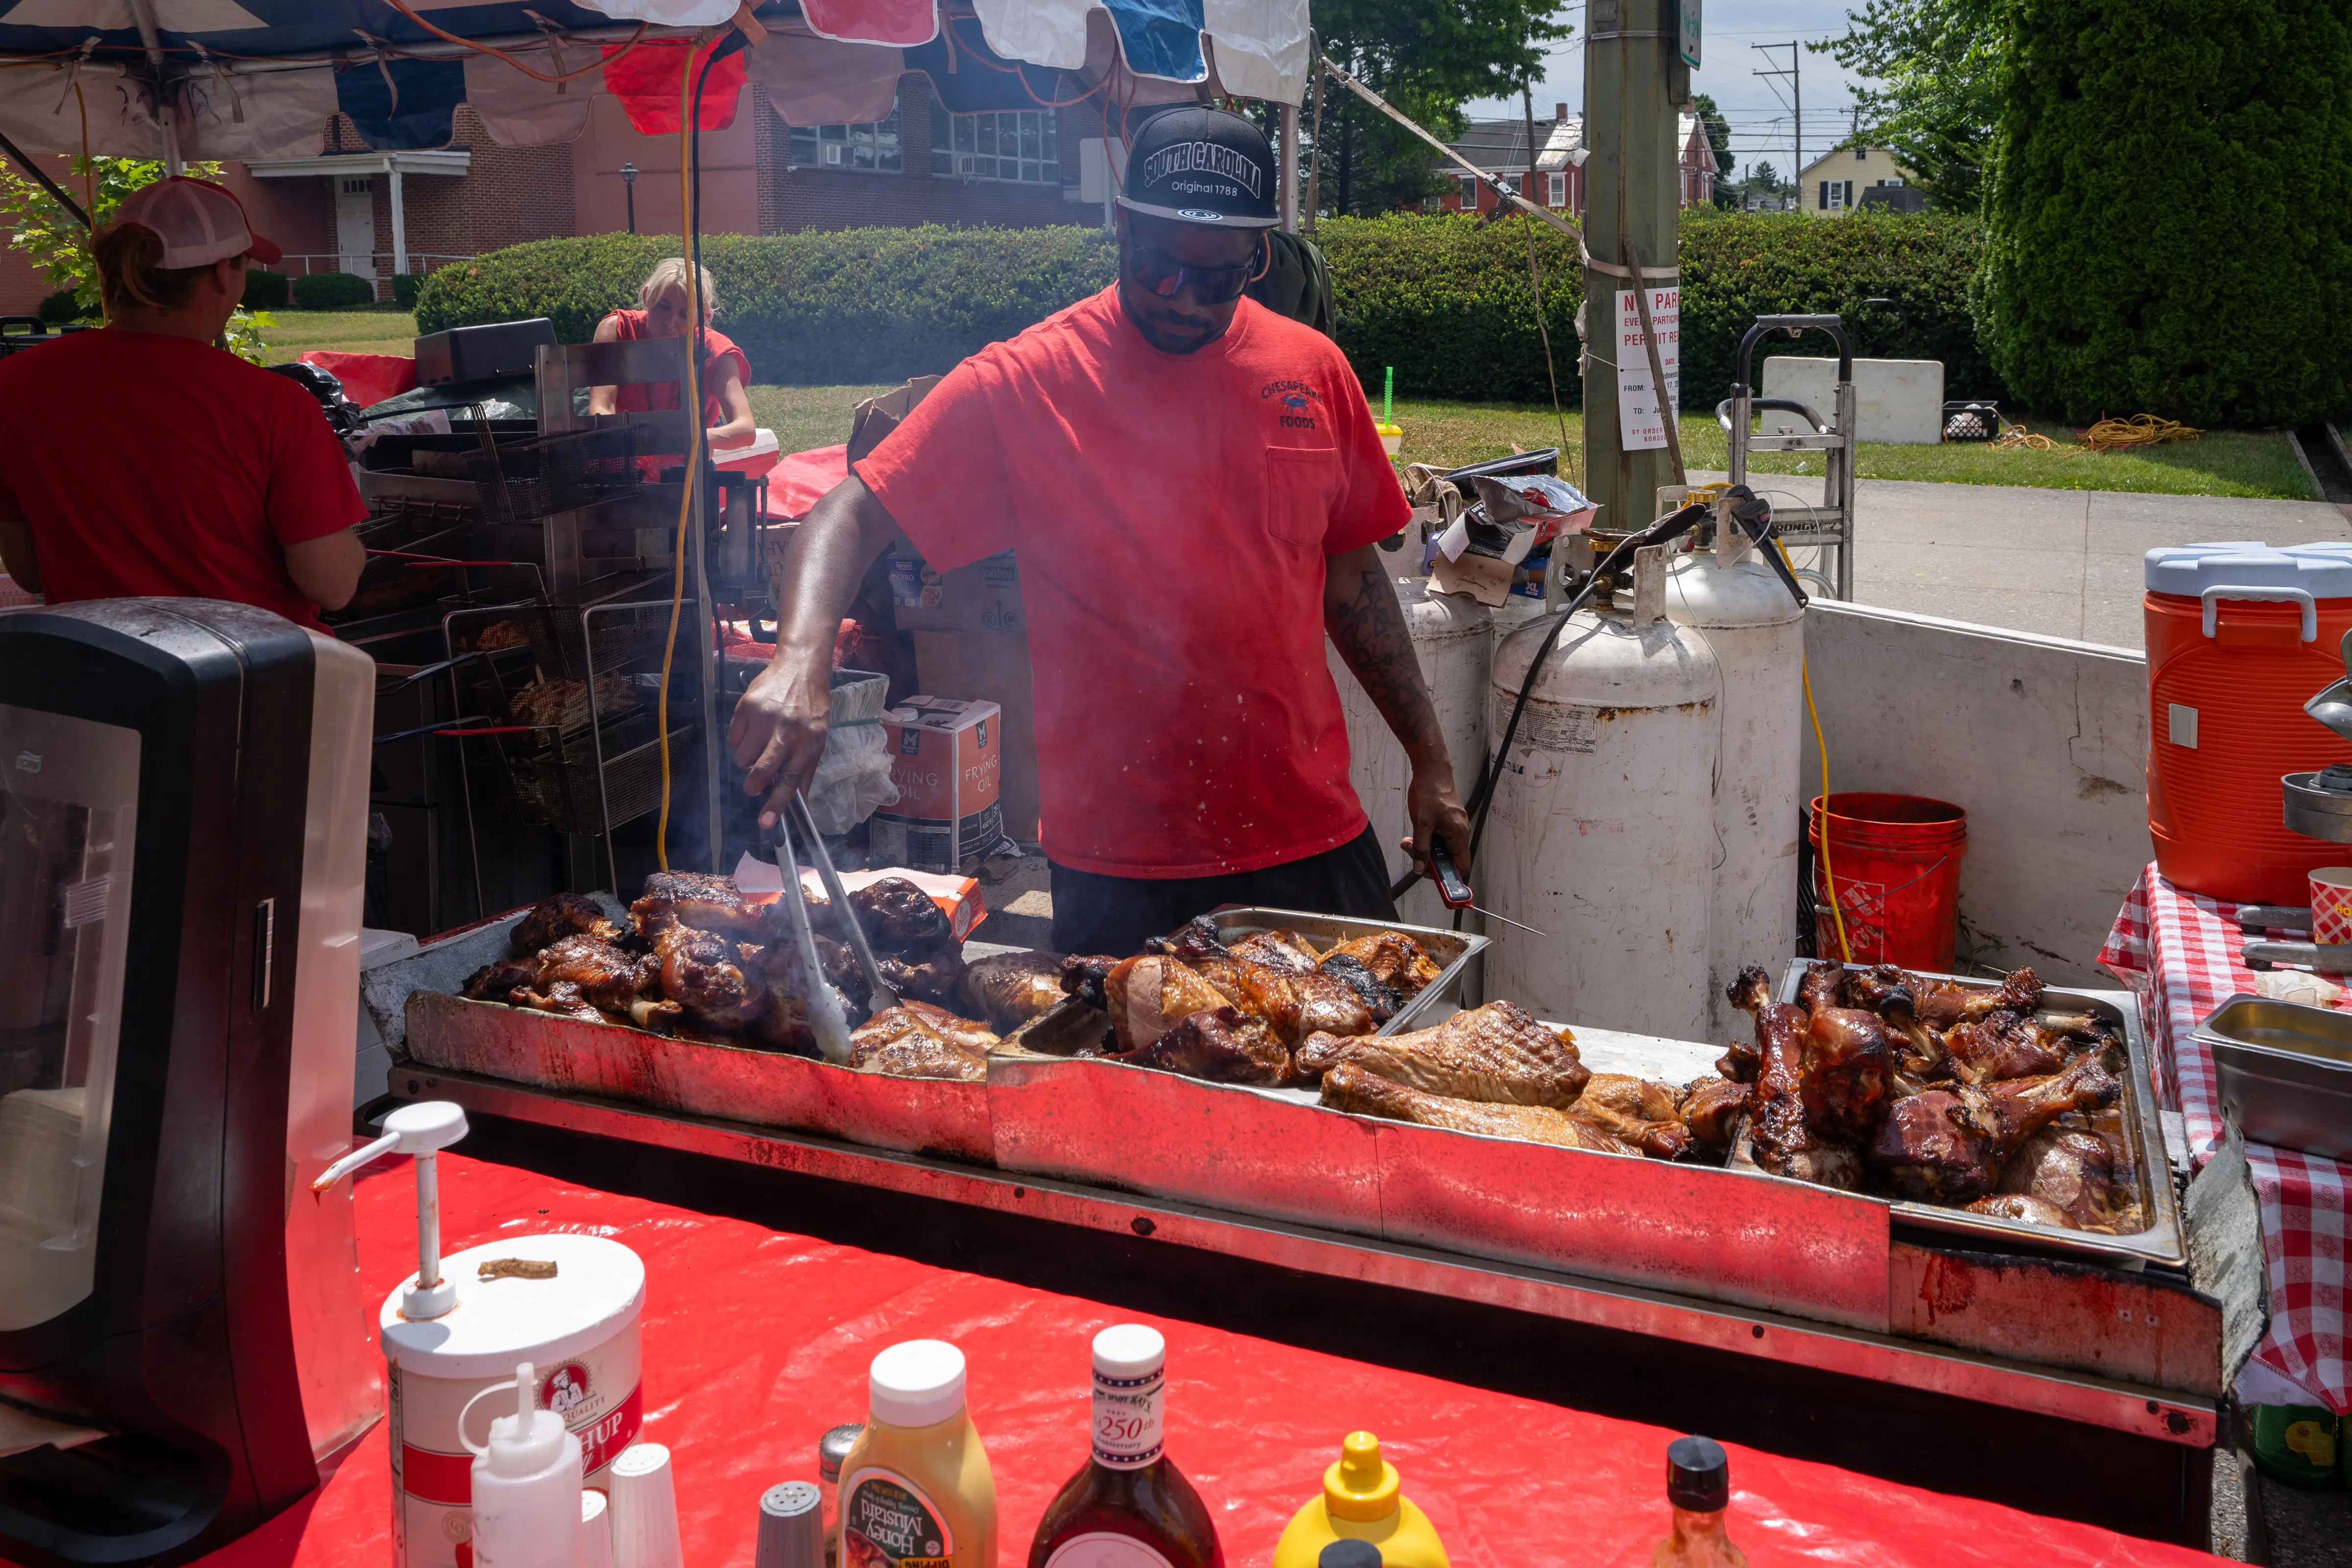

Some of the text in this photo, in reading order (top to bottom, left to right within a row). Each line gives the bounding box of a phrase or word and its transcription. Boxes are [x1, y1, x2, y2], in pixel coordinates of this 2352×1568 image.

[1145, 142, 1261, 199] SOUTH CAROLINA
[1172, 180, 1237, 196] Original 1788
[1279, 416, 1316, 429] FOODS
[1525, 582, 1538, 592] XL
[889, 767, 938, 786] RYING
[965, 755, 997, 782] FRYING
[978, 776, 991, 792] OIL
[563, 1395, 606, 1422] QUALITY
[1097, 1436, 1141, 1449] Anniversary
[861, 1498, 923, 1536] Mustard
[866, 1519, 915, 1555] Honey
